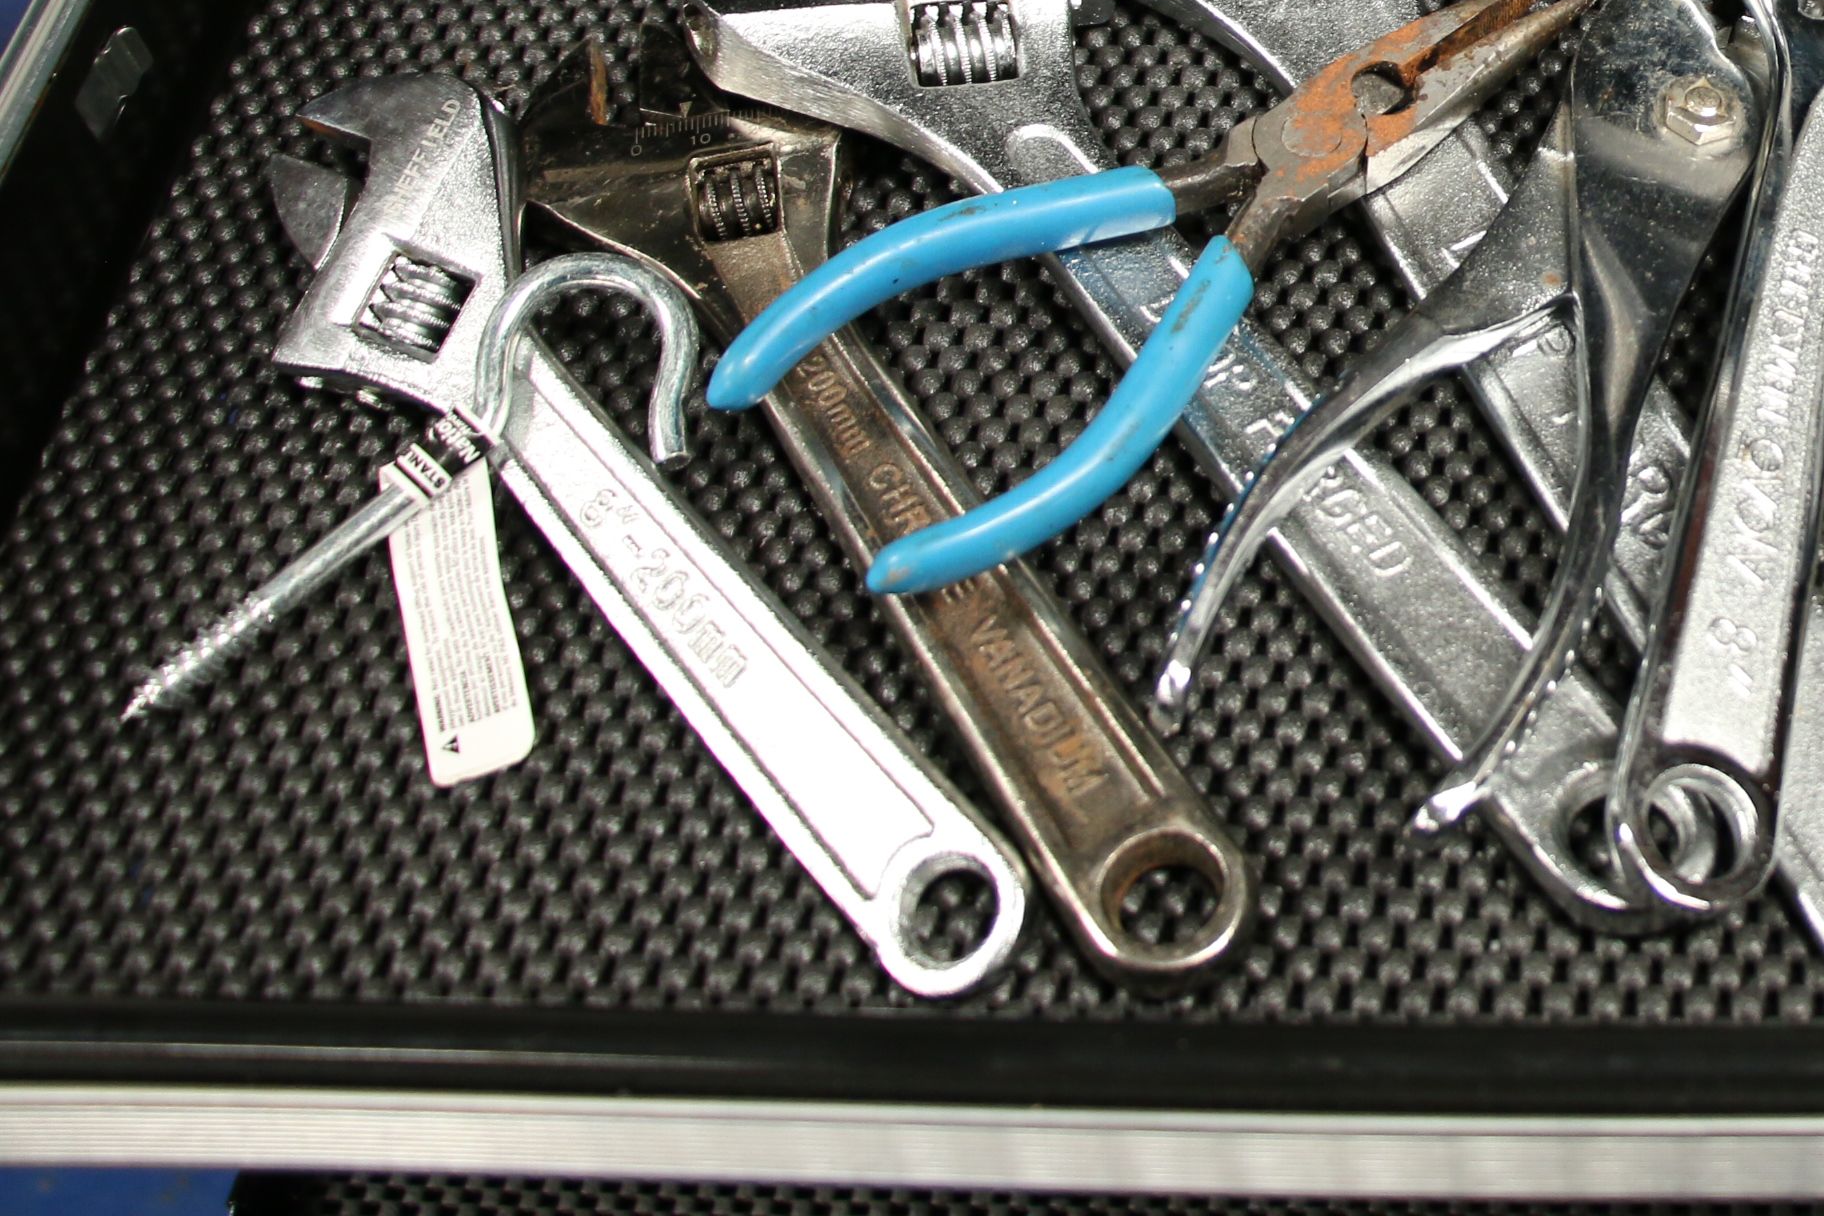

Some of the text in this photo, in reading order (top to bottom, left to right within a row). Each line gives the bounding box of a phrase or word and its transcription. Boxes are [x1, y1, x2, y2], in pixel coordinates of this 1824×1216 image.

[690, 133, 709, 145] 10
[1243, 407, 1415, 580] FRGED
[866, 464, 977, 607] CHRE
[965, 613, 1105, 797] VANADIUM
